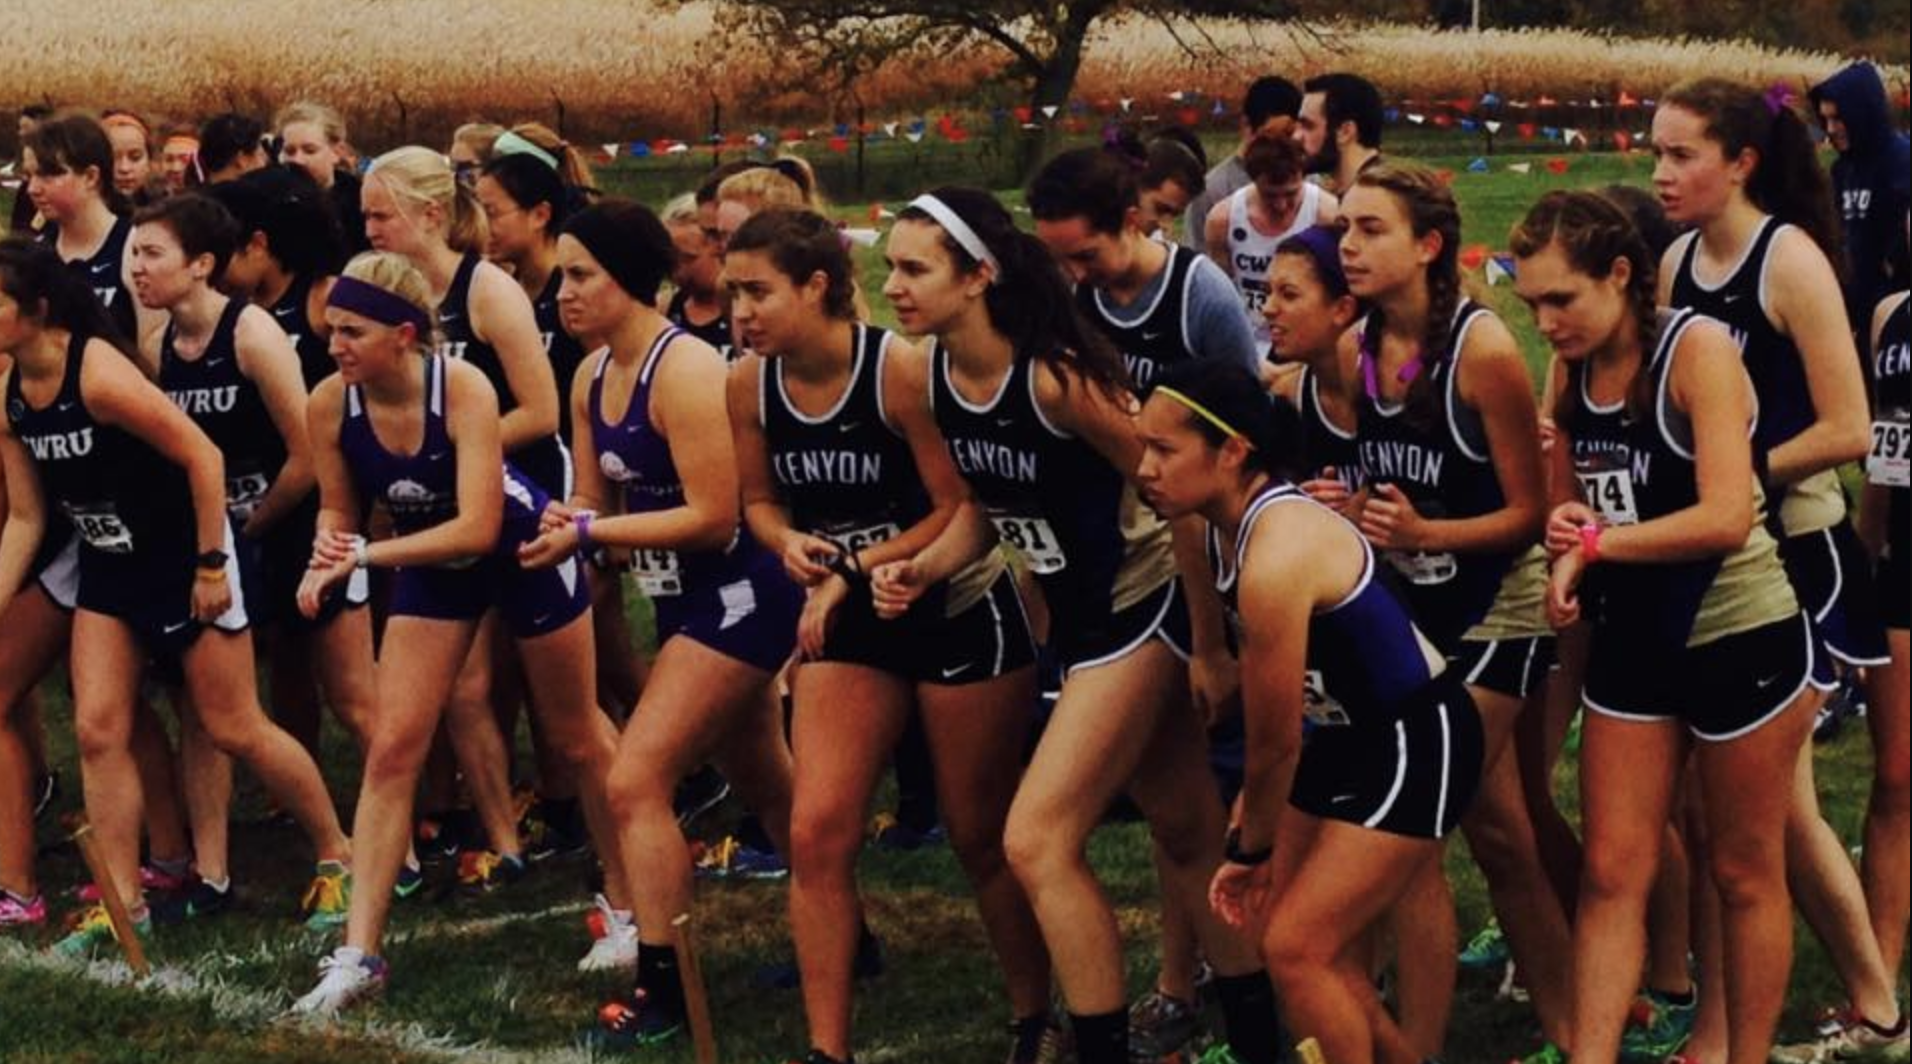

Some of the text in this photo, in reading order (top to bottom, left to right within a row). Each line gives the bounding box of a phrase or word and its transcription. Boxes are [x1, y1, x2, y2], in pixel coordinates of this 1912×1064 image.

[1236, 252, 1272, 273] CW
[164, 384, 240, 413] WRU
[21, 426, 94, 460] WRU
[952, 437, 1037, 483] ENYON
[1003, 520, 1046, 550] 81
